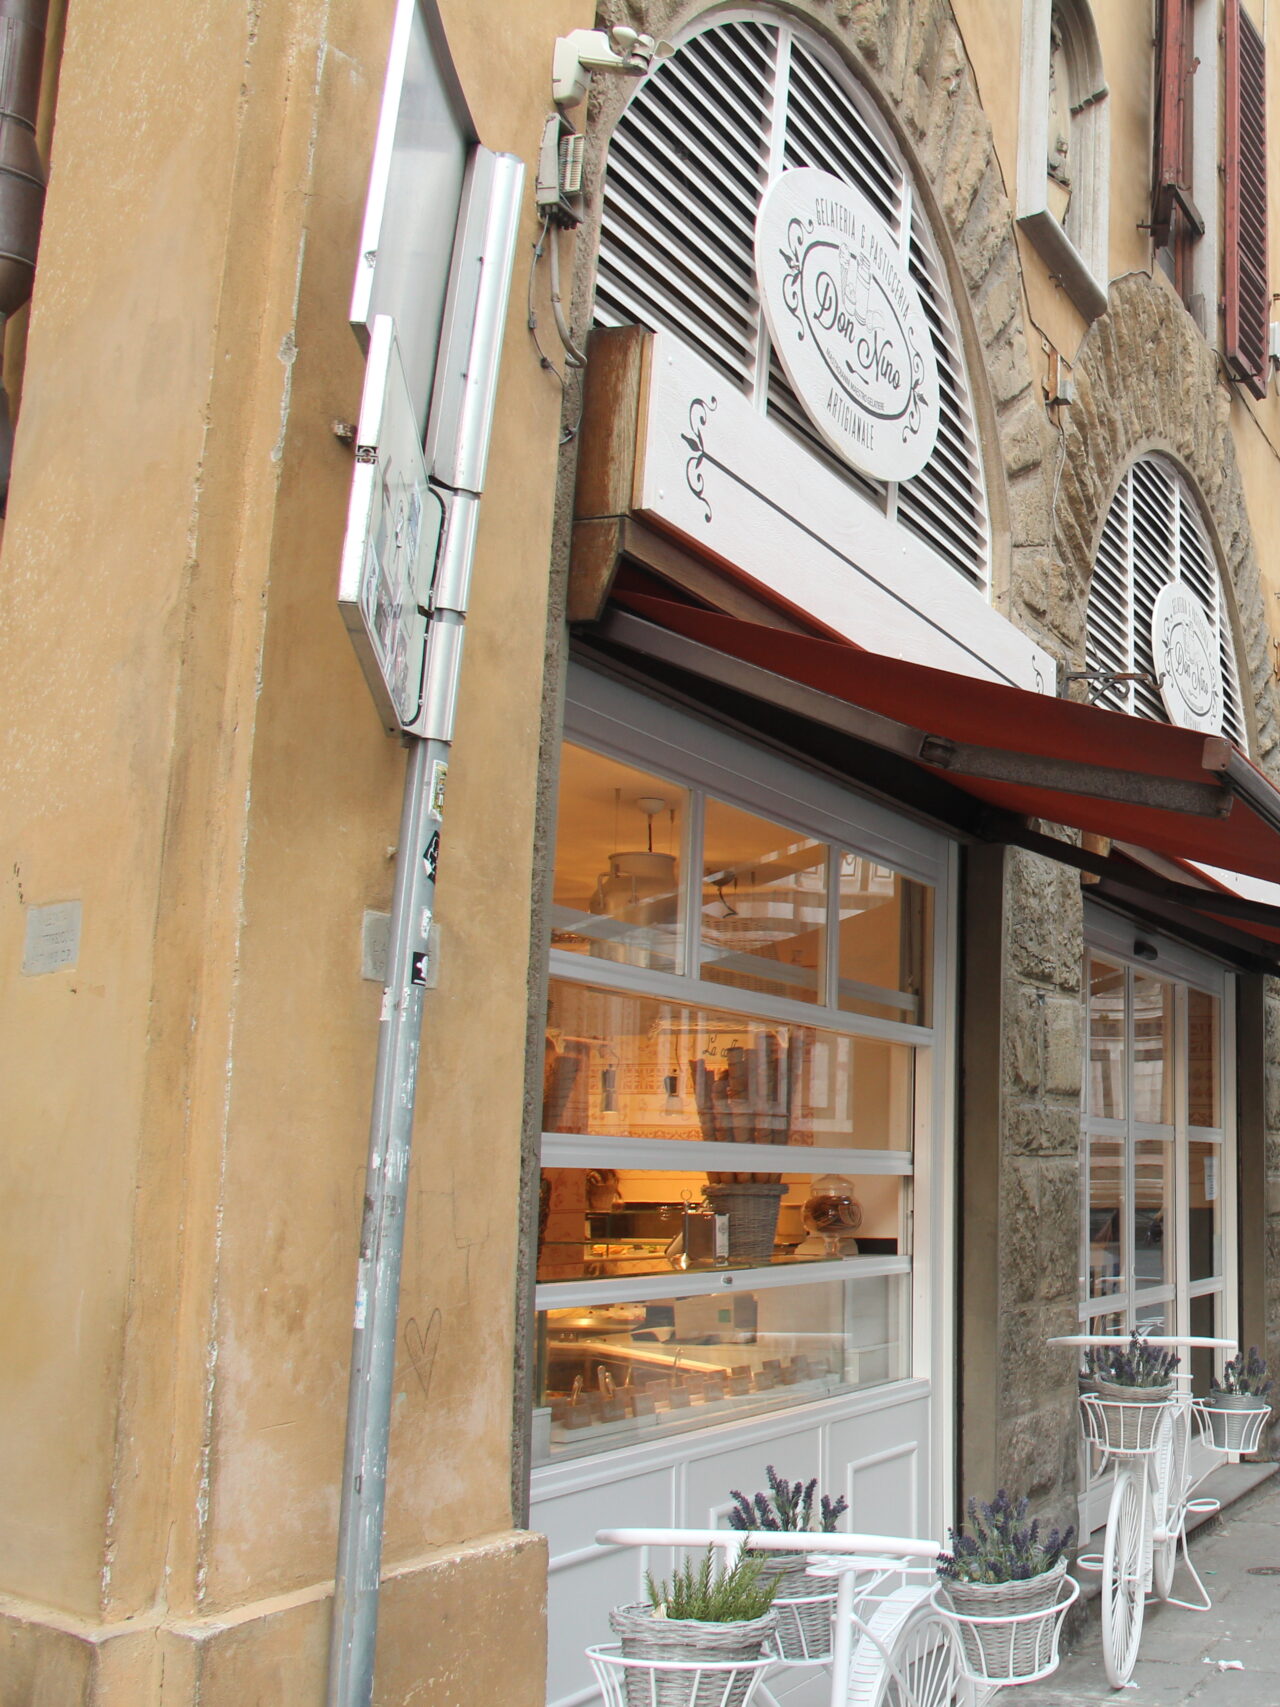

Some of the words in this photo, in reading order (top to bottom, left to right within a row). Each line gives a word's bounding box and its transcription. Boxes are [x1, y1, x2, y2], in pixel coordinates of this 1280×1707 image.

[815, 198, 856, 241] GELATERIA
[860, 224, 866, 249] &
[869, 234, 911, 321] PASTICCERIA
[813, 271, 855, 344] Don
[857, 329, 901, 390] Nino
[826, 386, 875, 451] ARTIGIANALE
[1175, 641, 1191, 678] Don
[1191, 662, 1209, 696] Nino
